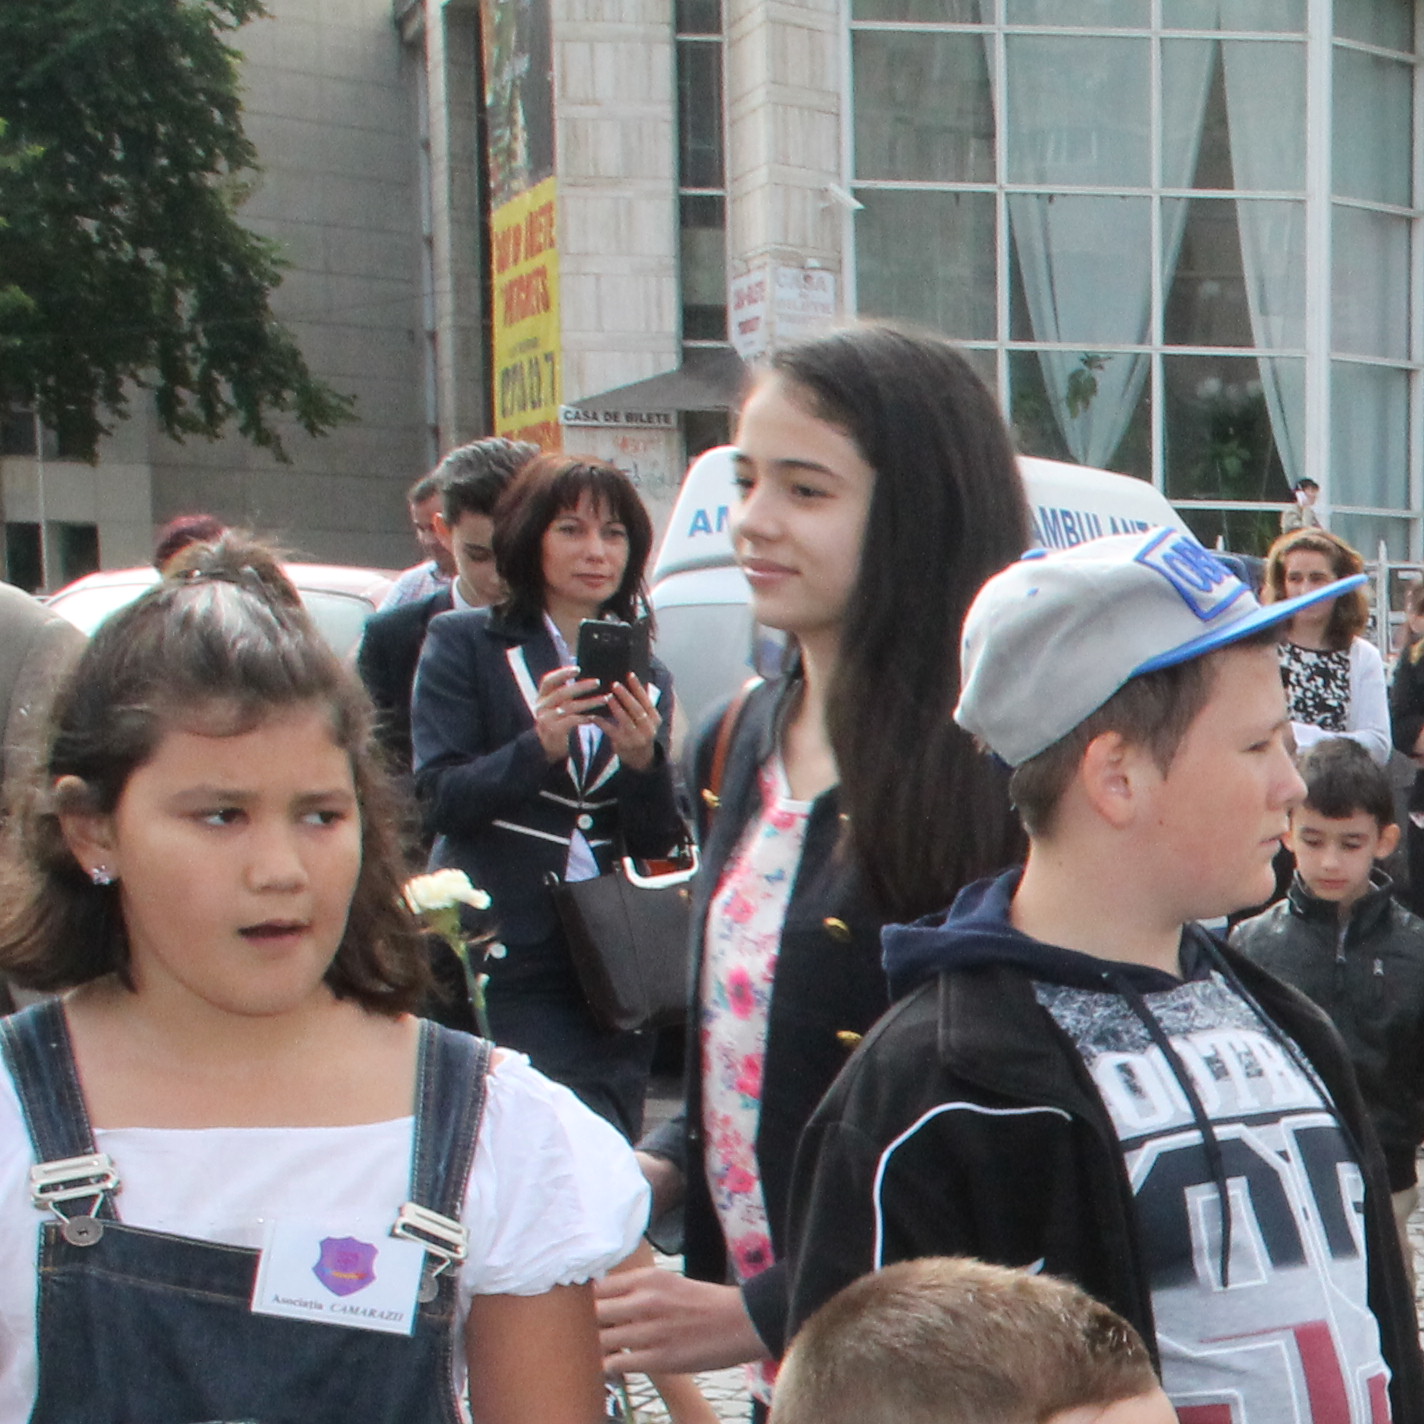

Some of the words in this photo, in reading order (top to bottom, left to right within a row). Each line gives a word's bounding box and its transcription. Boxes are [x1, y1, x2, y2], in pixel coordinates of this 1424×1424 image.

[564, 410, 598, 421] CASA
[604, 411, 620, 422] DE
[625, 412, 671, 424] BILETE
